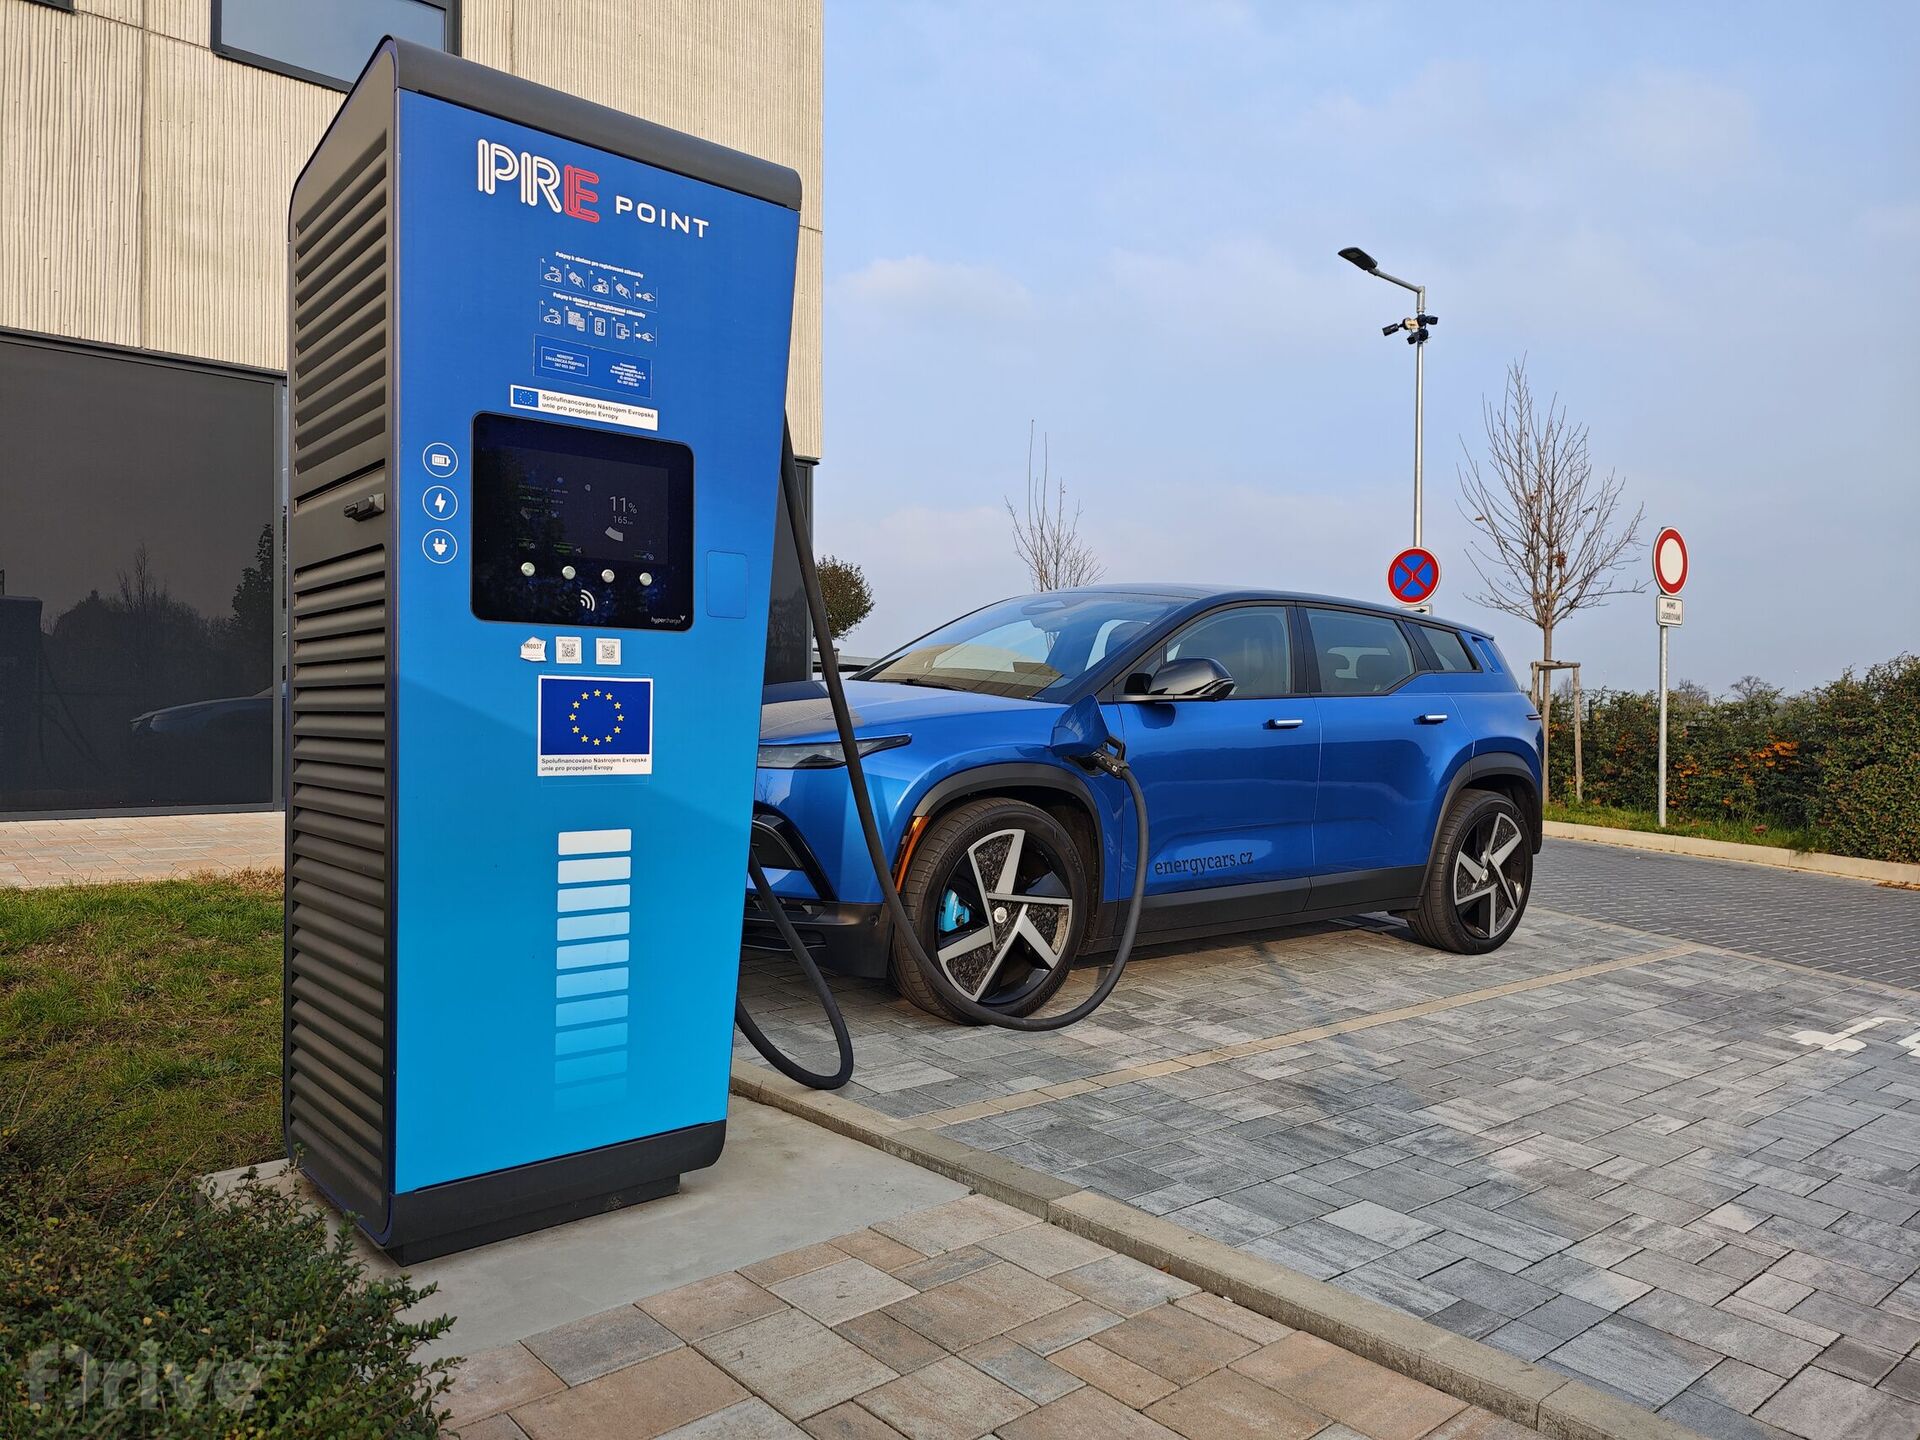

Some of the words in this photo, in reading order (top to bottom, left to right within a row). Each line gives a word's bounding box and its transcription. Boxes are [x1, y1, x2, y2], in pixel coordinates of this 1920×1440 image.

[477, 138, 600, 223] PRE
[615, 195, 710, 238] POINT
[542, 394, 595, 408] Spolufinancováno
[597, 403, 626, 414] Nástrojem
[628, 408, 653, 418] Evropské
[568, 406, 596, 416] propojení
[598, 411, 618, 420] Evropy
[1155, 851, 1254, 876] energycars.cz
